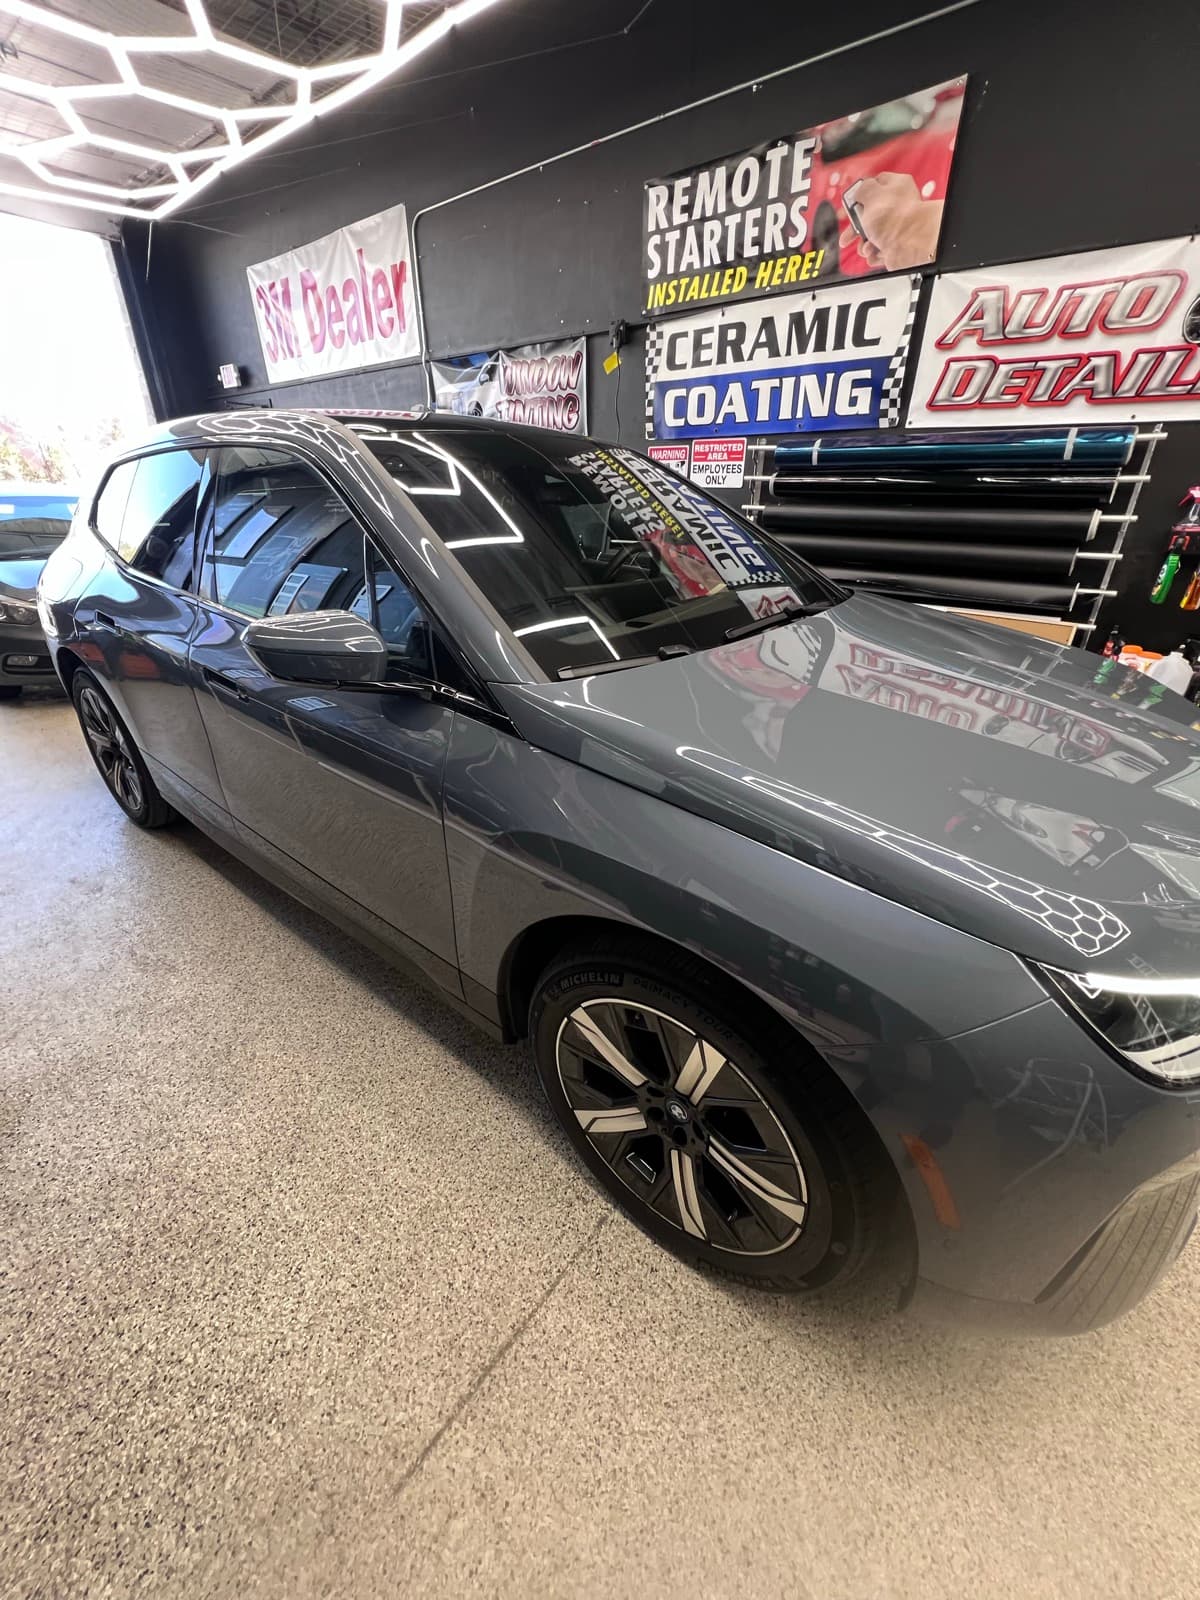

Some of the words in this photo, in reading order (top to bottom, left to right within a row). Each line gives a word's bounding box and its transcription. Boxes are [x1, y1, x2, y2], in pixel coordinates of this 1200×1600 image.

[647, 137, 816, 233] REMOTE
[647, 195, 808, 279] STARTERS
[300, 247, 407, 354] Dealer
[646, 266, 748, 310] INSTALLED
[754, 249, 825, 289] HERE!
[666, 298, 887, 371] CERAMIC
[935, 270, 1187, 349] AUTO
[664, 369, 873, 427] COATING
[926, 344, 1200, 411] DETAIL
[496, 392, 580, 430] TINTING
[651, 448, 686, 460] WARNING
[692, 463, 743, 474] EMPLOYEES
[694, 443, 743, 453] RESTRICTED
[707, 452, 728, 461] AREA
[705, 475, 727, 485] ONLY
[560, 972, 620, 988] MICHELIN
